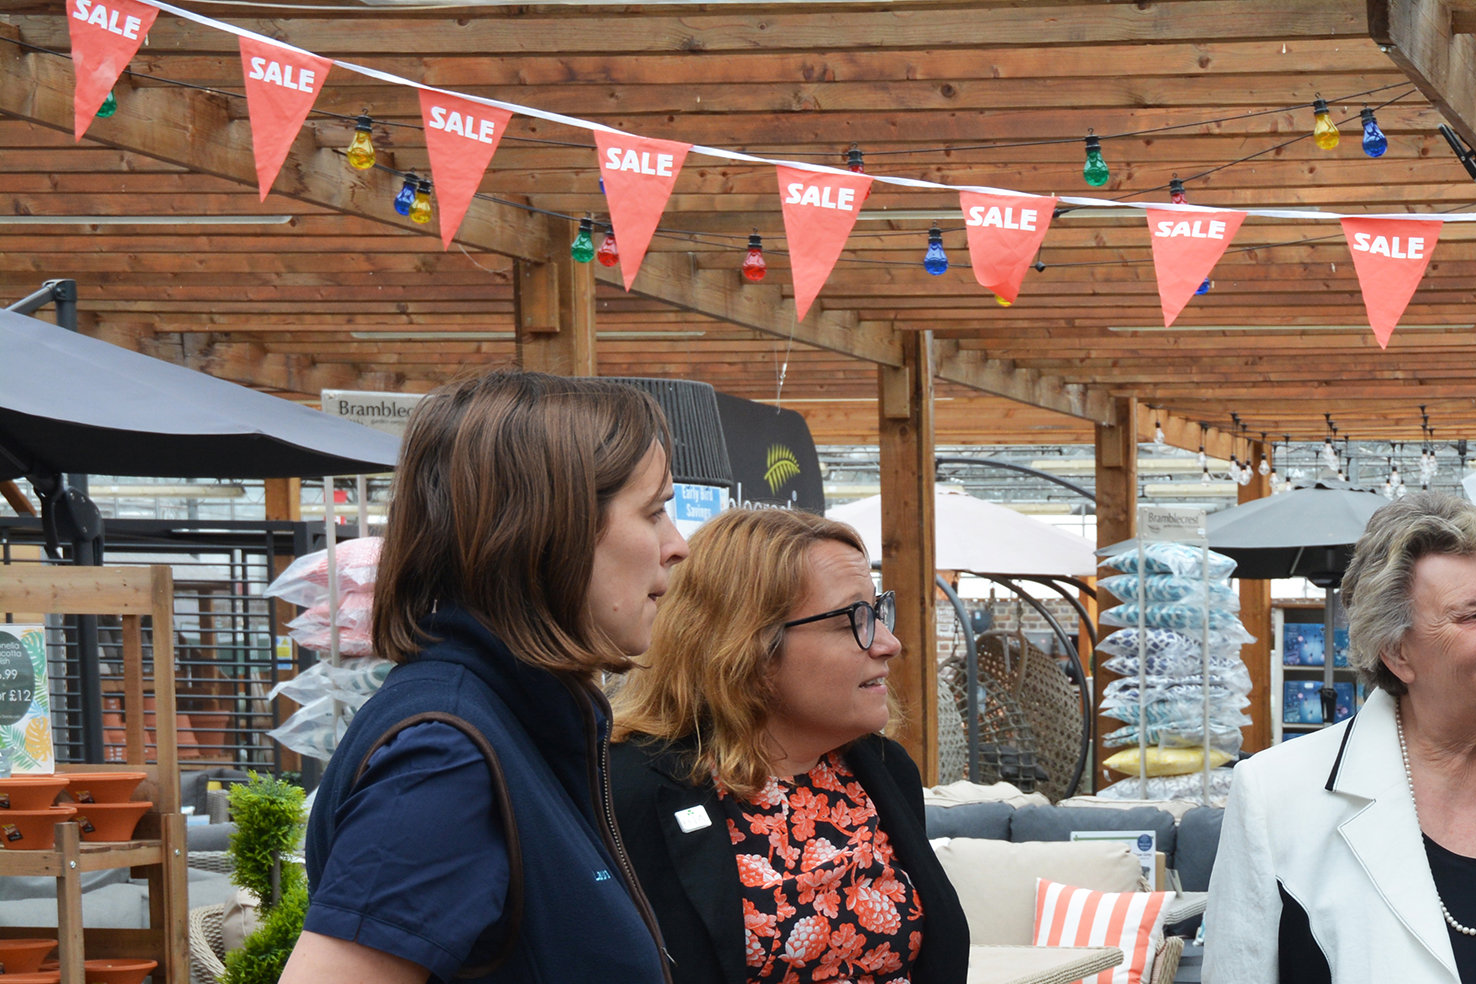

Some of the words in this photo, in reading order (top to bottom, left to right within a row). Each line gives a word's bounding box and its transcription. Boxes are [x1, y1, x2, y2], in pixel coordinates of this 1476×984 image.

[72, 0, 141, 40] SALE
[249, 57, 315, 94] SALE
[429, 107, 495, 144] SALE
[605, 147, 673, 178] SALE
[785, 183, 855, 211] SALE
[966, 206, 1037, 232] SALE
[1155, 219, 1226, 240] SALE
[1353, 232, 1424, 260] SALE
[340, 400, 414, 417] Bramblec
[686, 503, 711, 521] Savings
[0, 669, 18, 680] .99
[10, 690, 31, 701] £12
